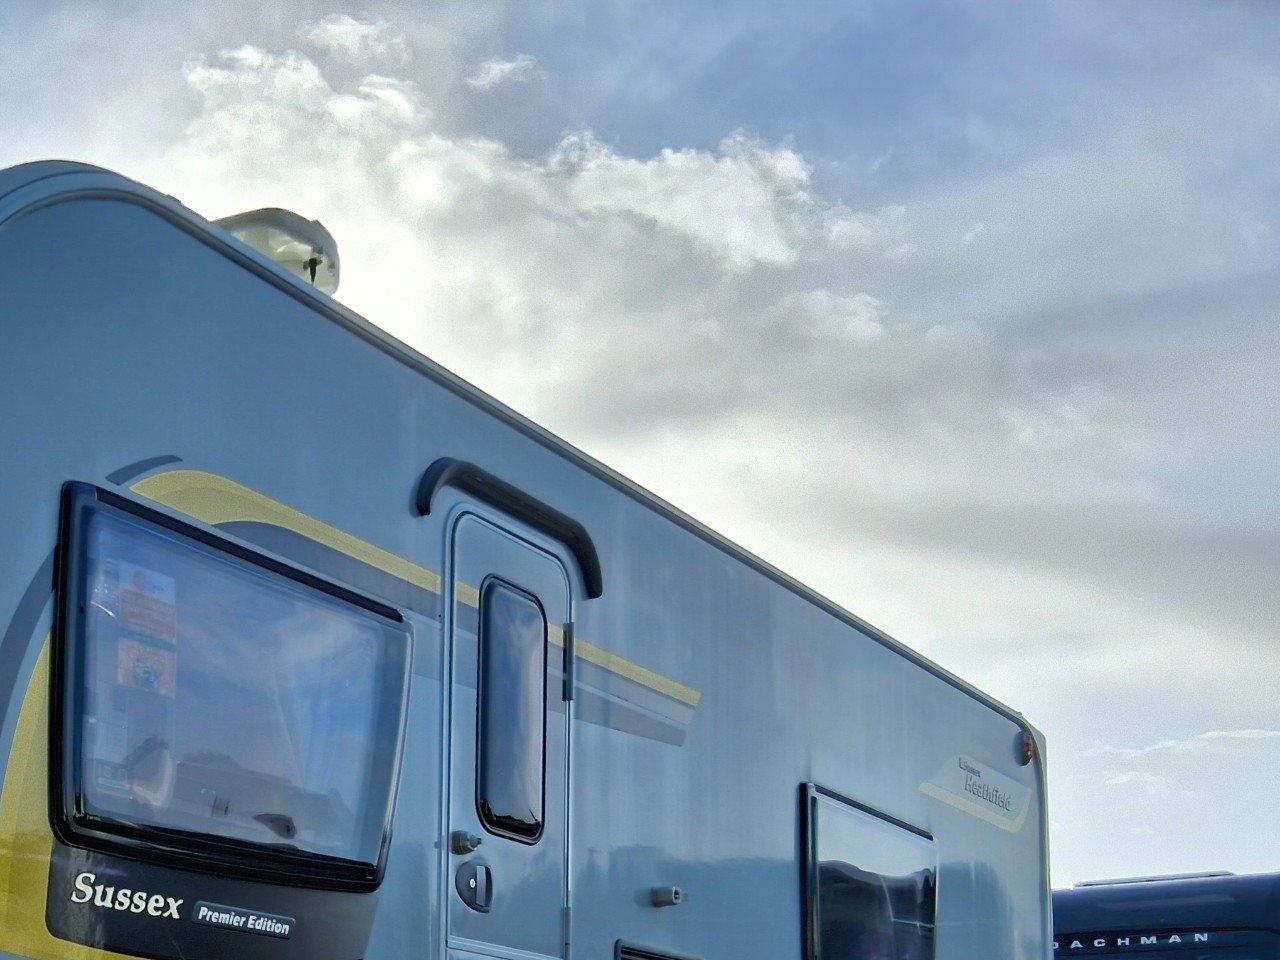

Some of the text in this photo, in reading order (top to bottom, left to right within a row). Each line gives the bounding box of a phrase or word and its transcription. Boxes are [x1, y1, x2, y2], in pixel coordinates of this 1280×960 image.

[71, 872, 184, 919] Sussex
[198, 906, 290, 935] Premier Edition
